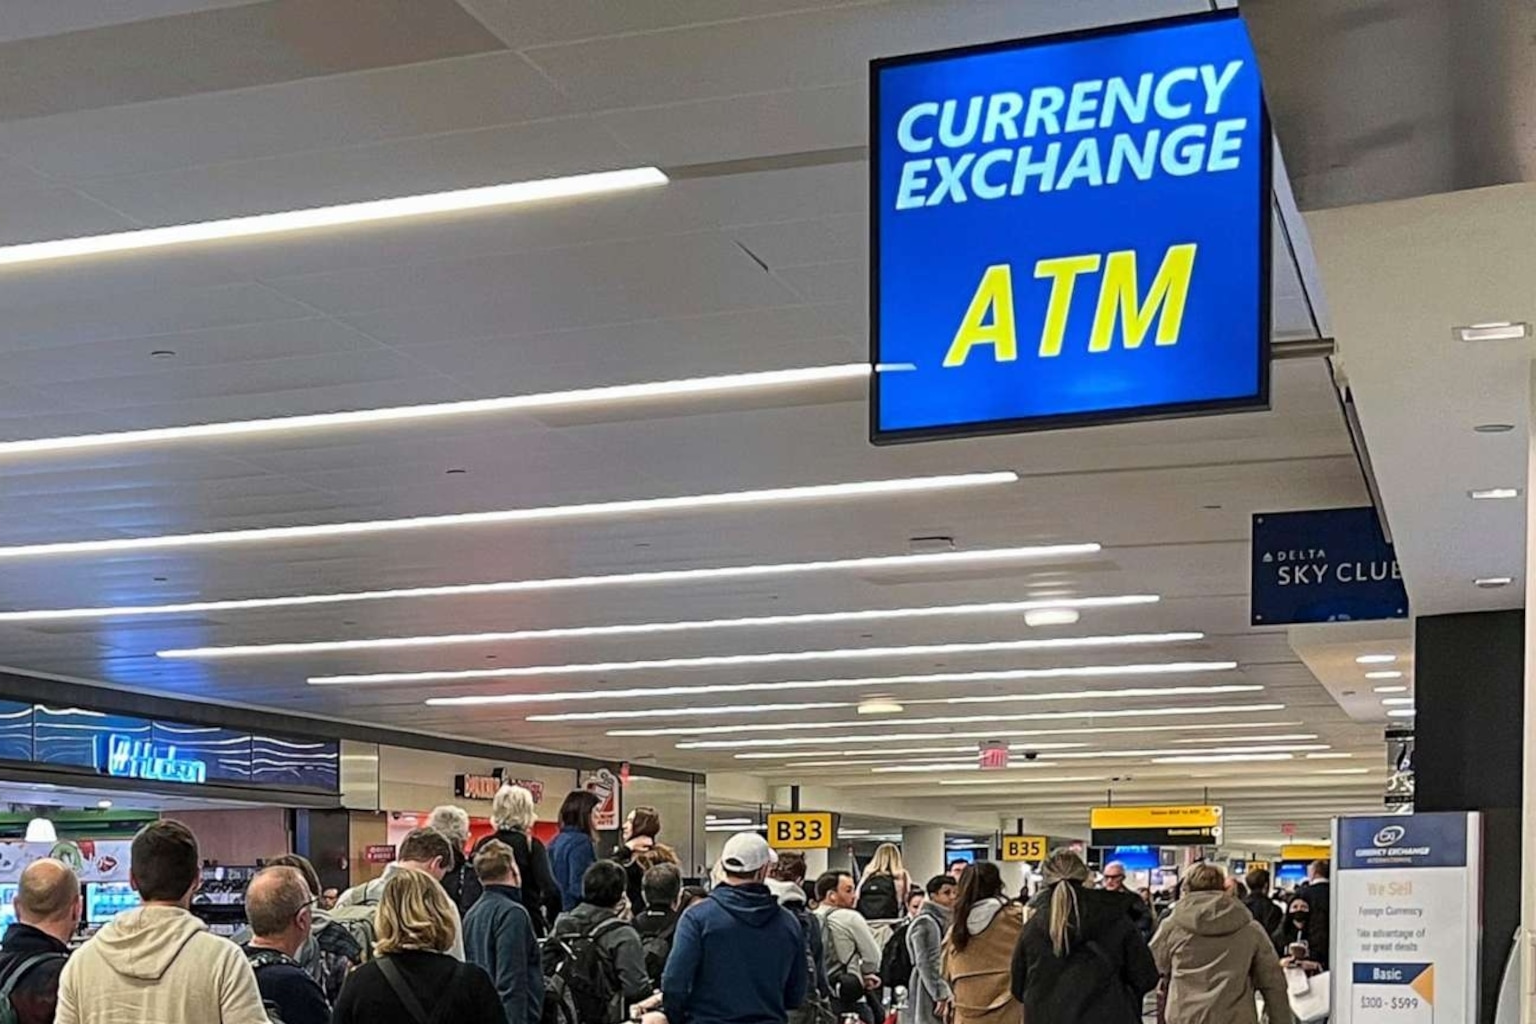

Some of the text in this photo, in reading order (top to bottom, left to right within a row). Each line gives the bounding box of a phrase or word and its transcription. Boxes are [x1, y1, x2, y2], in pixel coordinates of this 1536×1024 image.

[897, 60, 1244, 153] CURRENCY
[895, 118, 1247, 210] EXCHANGE
[942, 243, 1198, 368] ATM
[1278, 549, 1326, 561] DELTA
[1278, 563, 1328, 585] SKY
[130, 741, 206, 784] Hudson
[777, 820, 822, 841] B33
[1009, 841, 1040, 856] B35
[1388, 846, 1430, 857] EXCHANGE
[1367, 881, 1413, 896] We Sell
[1358, 906, 1423, 918] Foreign Currency
[1372, 928, 1413, 941] advantage
[1415, 927, 1426, 938] of
[1373, 941, 1393, 953] great
[1395, 941, 1418, 952] deals
[1373, 968, 1402, 980] Basic
[1391, 996, 1419, 1009] $599
